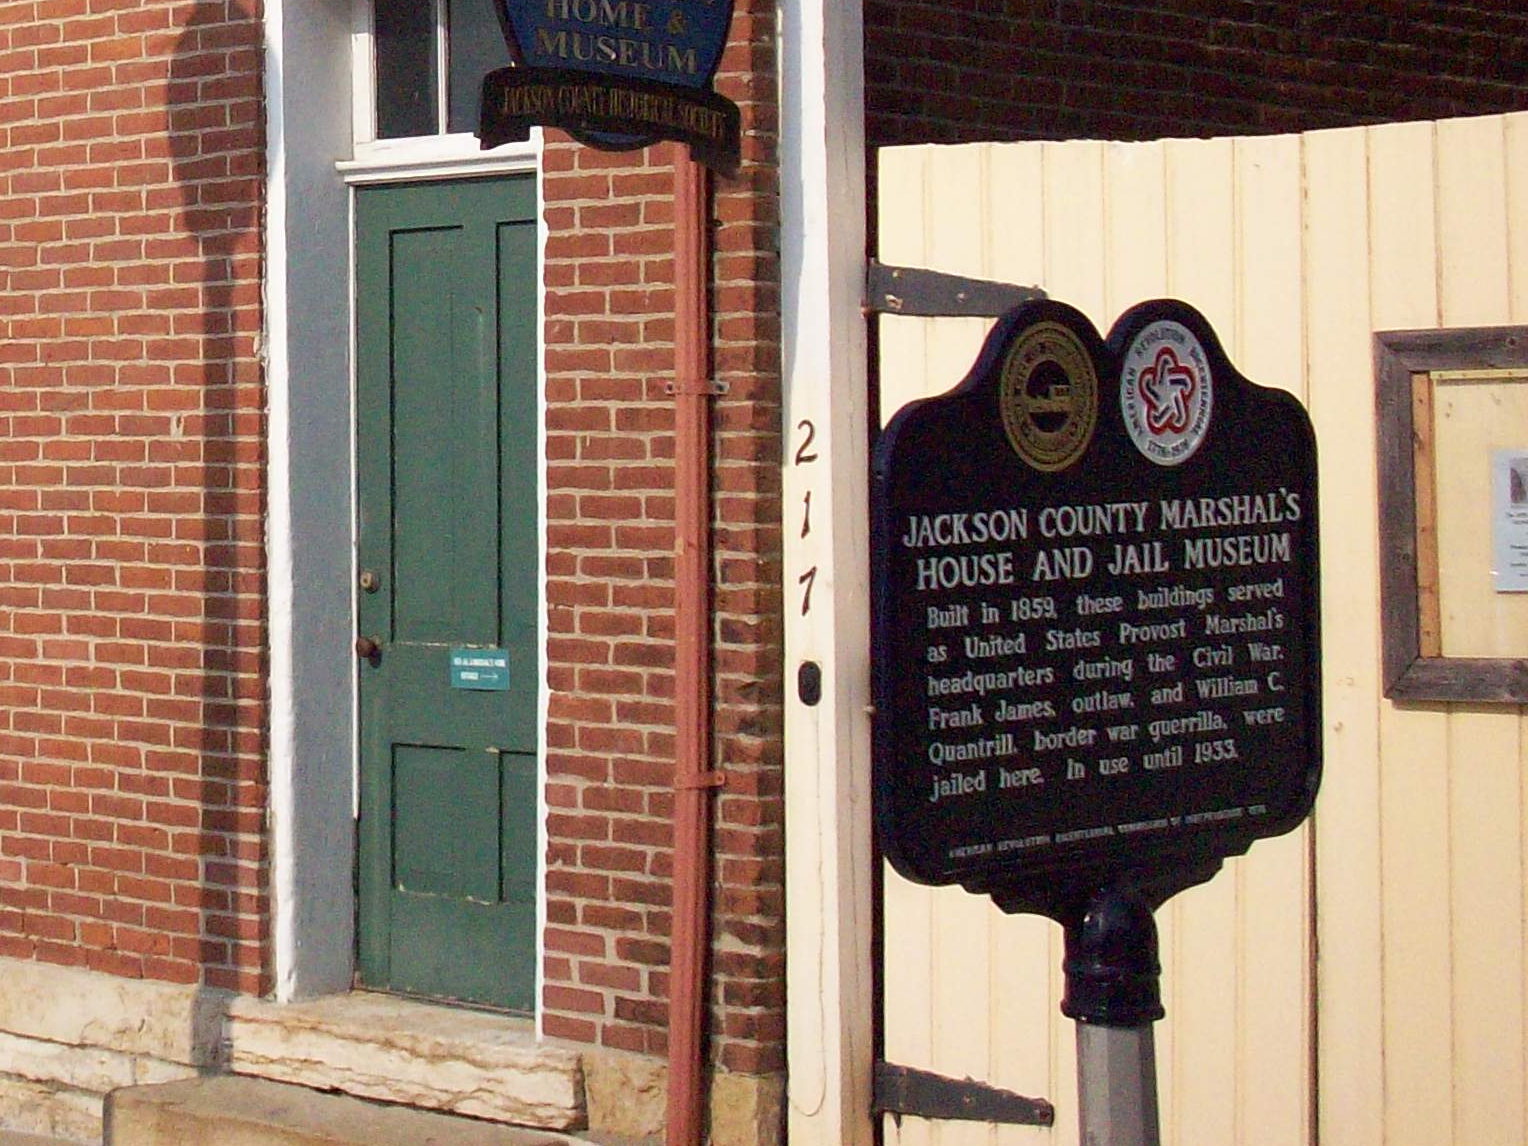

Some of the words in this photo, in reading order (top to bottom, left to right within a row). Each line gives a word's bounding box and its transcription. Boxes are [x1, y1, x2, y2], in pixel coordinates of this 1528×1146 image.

[668, 9, 687, 35] &
[535, 27, 697, 74] MUSEUM
[902, 509, 1027, 548] JACKSON
[1039, 501, 1149, 538] COUNTY
[1159, 487, 1301, 530] MARSHAL'S
[916, 552, 1015, 590] HOUSE
[1032, 546, 1094, 582] AND
[1108, 541, 1170, 576] JAIL
[1183, 532, 1292, 570] MUSEUM
[927, 604, 970, 629] Built
[981, 601, 1000, 625] in
[1076, 594, 1123, 616] these
[1137, 584, 1214, 610] buildings
[1227, 578, 1285, 602] served
[927, 644, 948, 662] as
[964, 633, 1027, 658] United
[1045, 627, 1101, 651] States
[1119, 618, 1186, 644] Provost
[1204, 606, 1285, 635] Marshal's
[927, 666, 1055, 697] headquarters
[1073, 656, 1133, 682] during
[1147, 653, 1176, 672] the
[1192, 644, 1233, 668] Civil
[1247, 641, 1285, 662] War.
[928, 703, 984, 730] Frank
[1150, 682, 1184, 705] and
[1196, 676, 1259, 699] William
[1267, 671, 1285, 692] C.
[1033, 726, 1097, 751] border
[1106, 724, 1140, 742] war
[1242, 707, 1286, 726] were
[929, 769, 987, 802] jailed
[998, 766, 1045, 789] here.
[1066, 757, 1086, 780] In
[1099, 756, 1129, 776] use
[1142, 745, 1184, 770] until
[1194, 738, 1239, 764] 1933.
